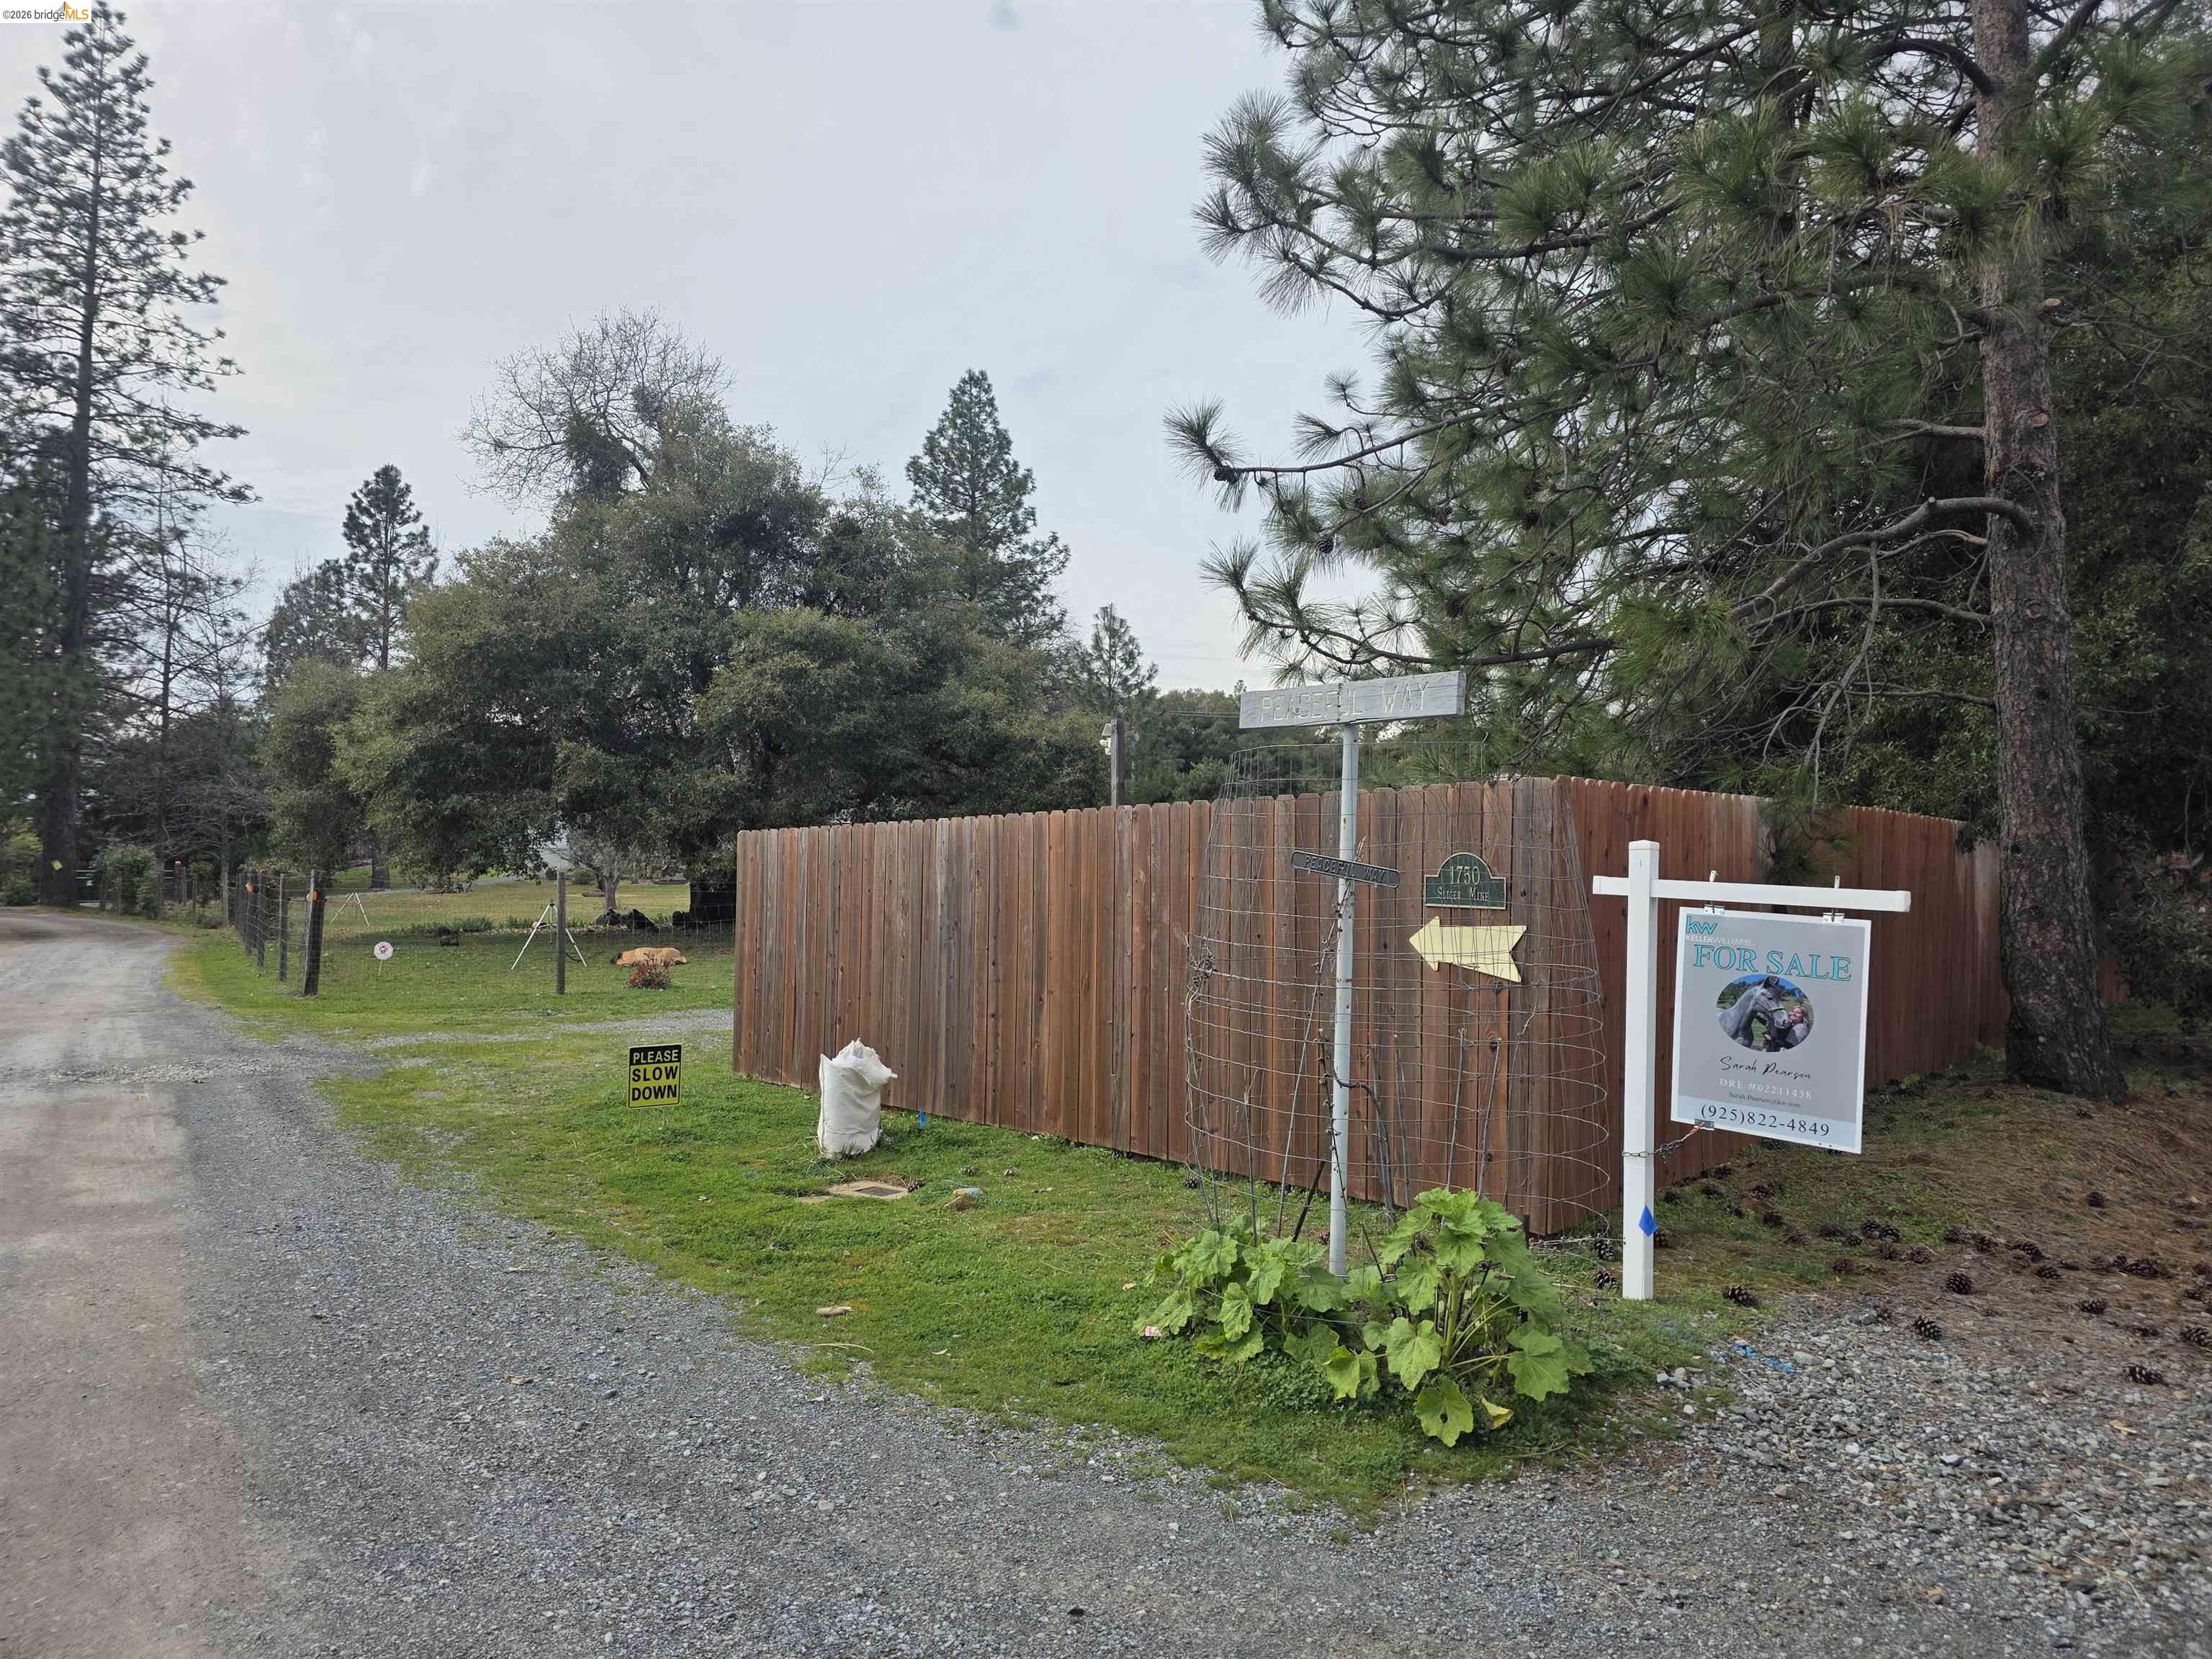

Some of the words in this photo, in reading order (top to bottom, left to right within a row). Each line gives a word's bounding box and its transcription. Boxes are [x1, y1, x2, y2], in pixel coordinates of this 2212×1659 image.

[1262, 689, 1364, 721] PEACEFUL
[1382, 682, 1429, 715] WAY
[1450, 866, 1480, 885] 1750
[1694, 944, 1758, 972] FOR
[1766, 950, 1852, 981] SALE
[633, 1049, 679, 1064] PLEASE
[632, 1066, 678, 1082] SLOW
[1720, 1056, 1757, 1071] Sarah
[1762, 1062, 1812, 1079] Pearson
[631, 1084, 678, 1101] DOWN
[1719, 1078, 1743, 1089] DRE
[1701, 1104, 1830, 1136] (925)822-4849
